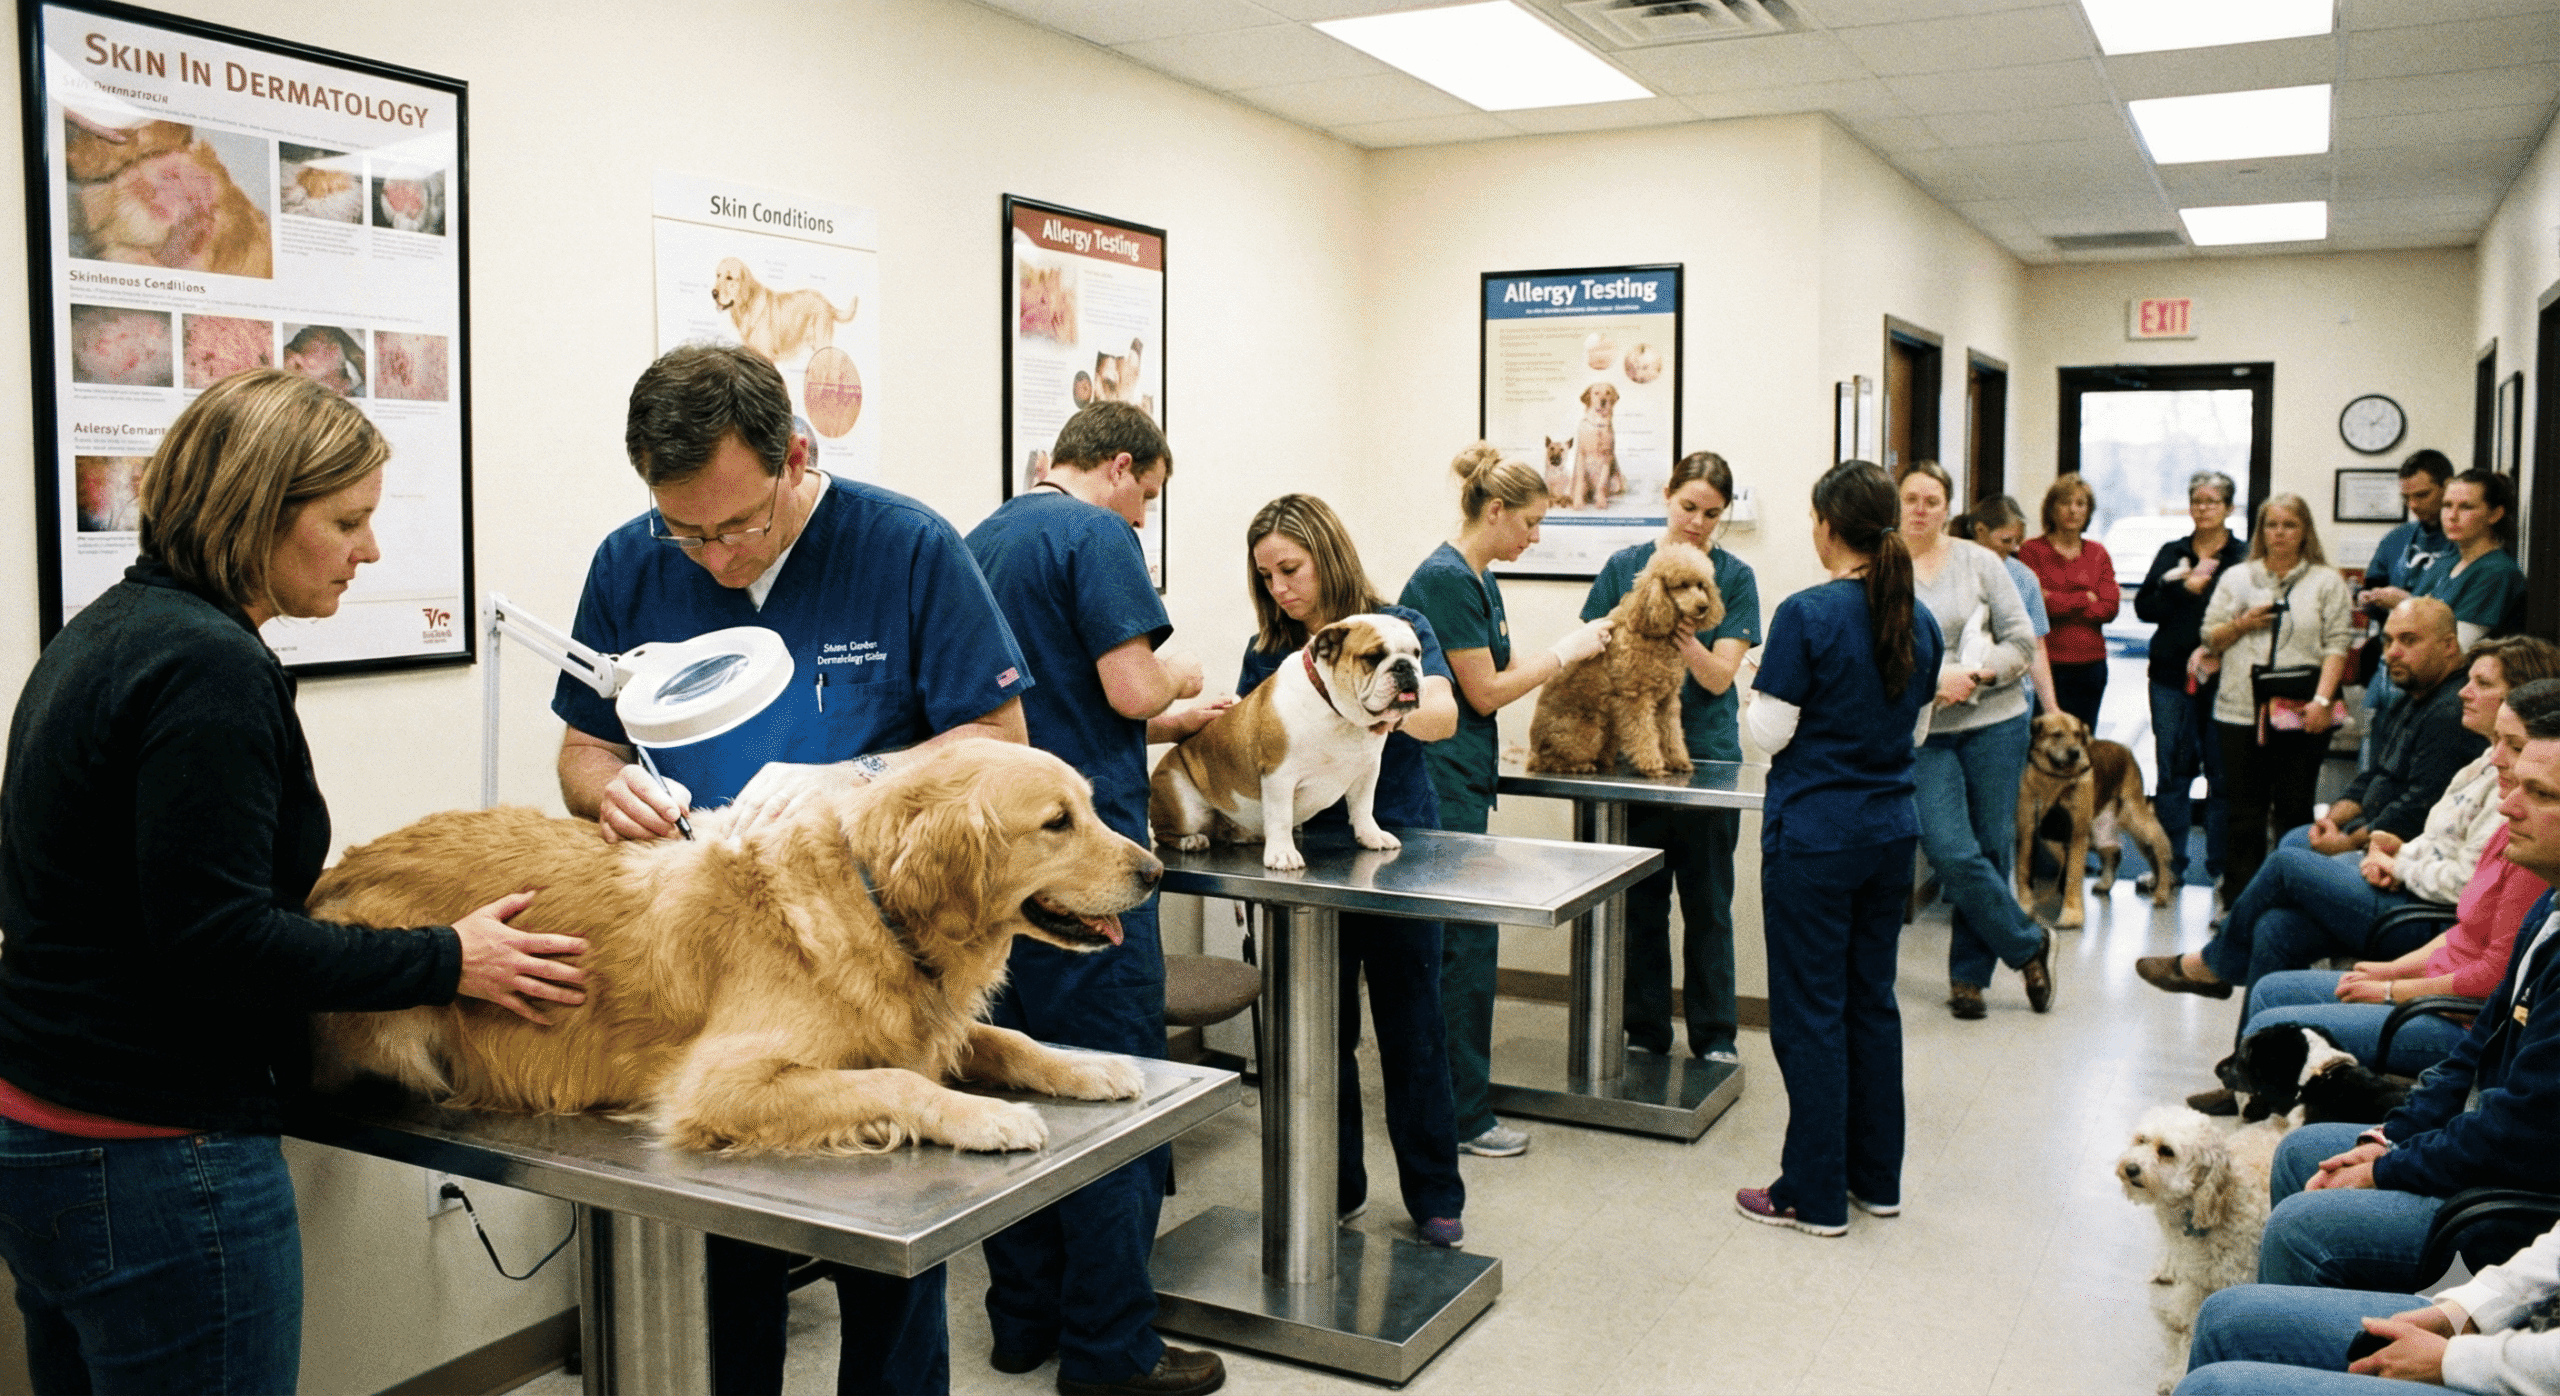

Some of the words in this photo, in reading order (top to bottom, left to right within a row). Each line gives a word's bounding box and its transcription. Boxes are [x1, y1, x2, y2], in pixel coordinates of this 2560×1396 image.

[710, 195, 747, 219] Skin
[752, 203, 834, 234] Conditions
[1042, 219, 1092, 253] Allergy
[1093, 229, 1140, 262] Testing
[1504, 281, 1577, 306] Allergy
[1580, 276, 1658, 302] Testing
[2140, 299, 2190, 333] EXIT
